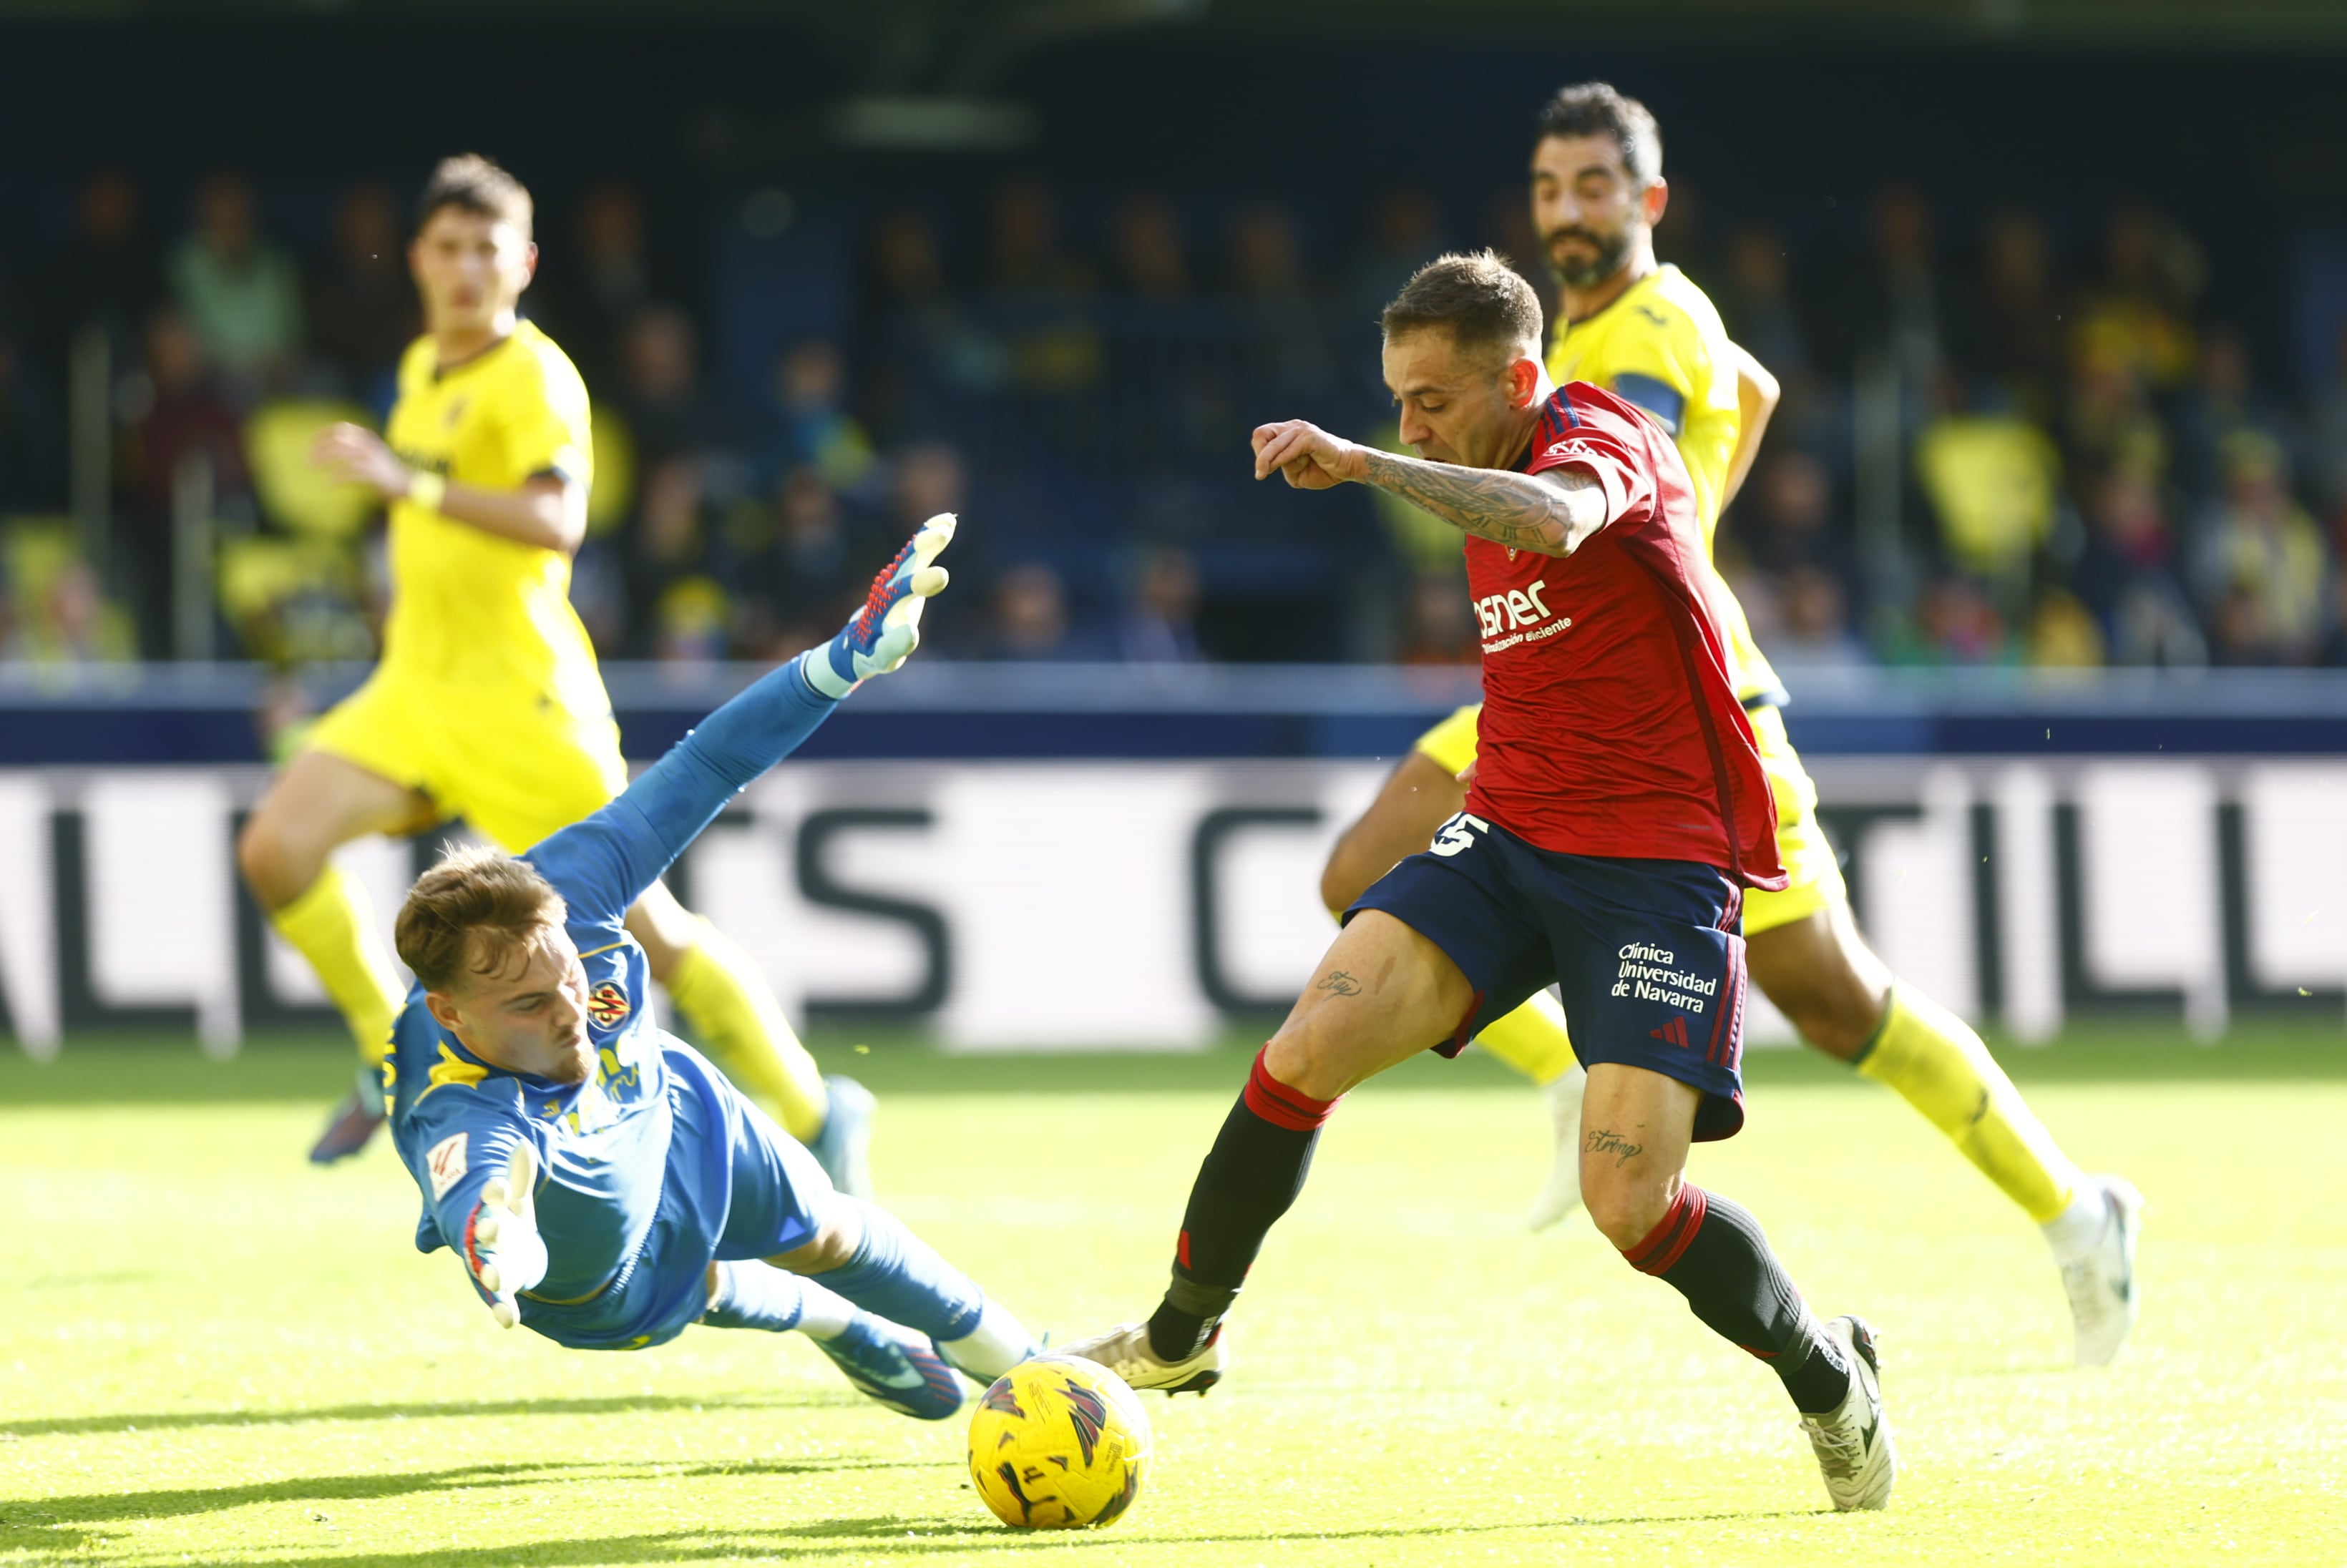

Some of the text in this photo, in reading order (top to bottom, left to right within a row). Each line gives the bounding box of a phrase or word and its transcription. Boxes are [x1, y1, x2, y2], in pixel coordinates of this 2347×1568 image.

[1619, 942, 1674, 964] Clínica
[1619, 961, 1717, 996] Universidad
[1611, 979, 1704, 1013] de Navarra
[1585, 1130, 1643, 1168] Strong
